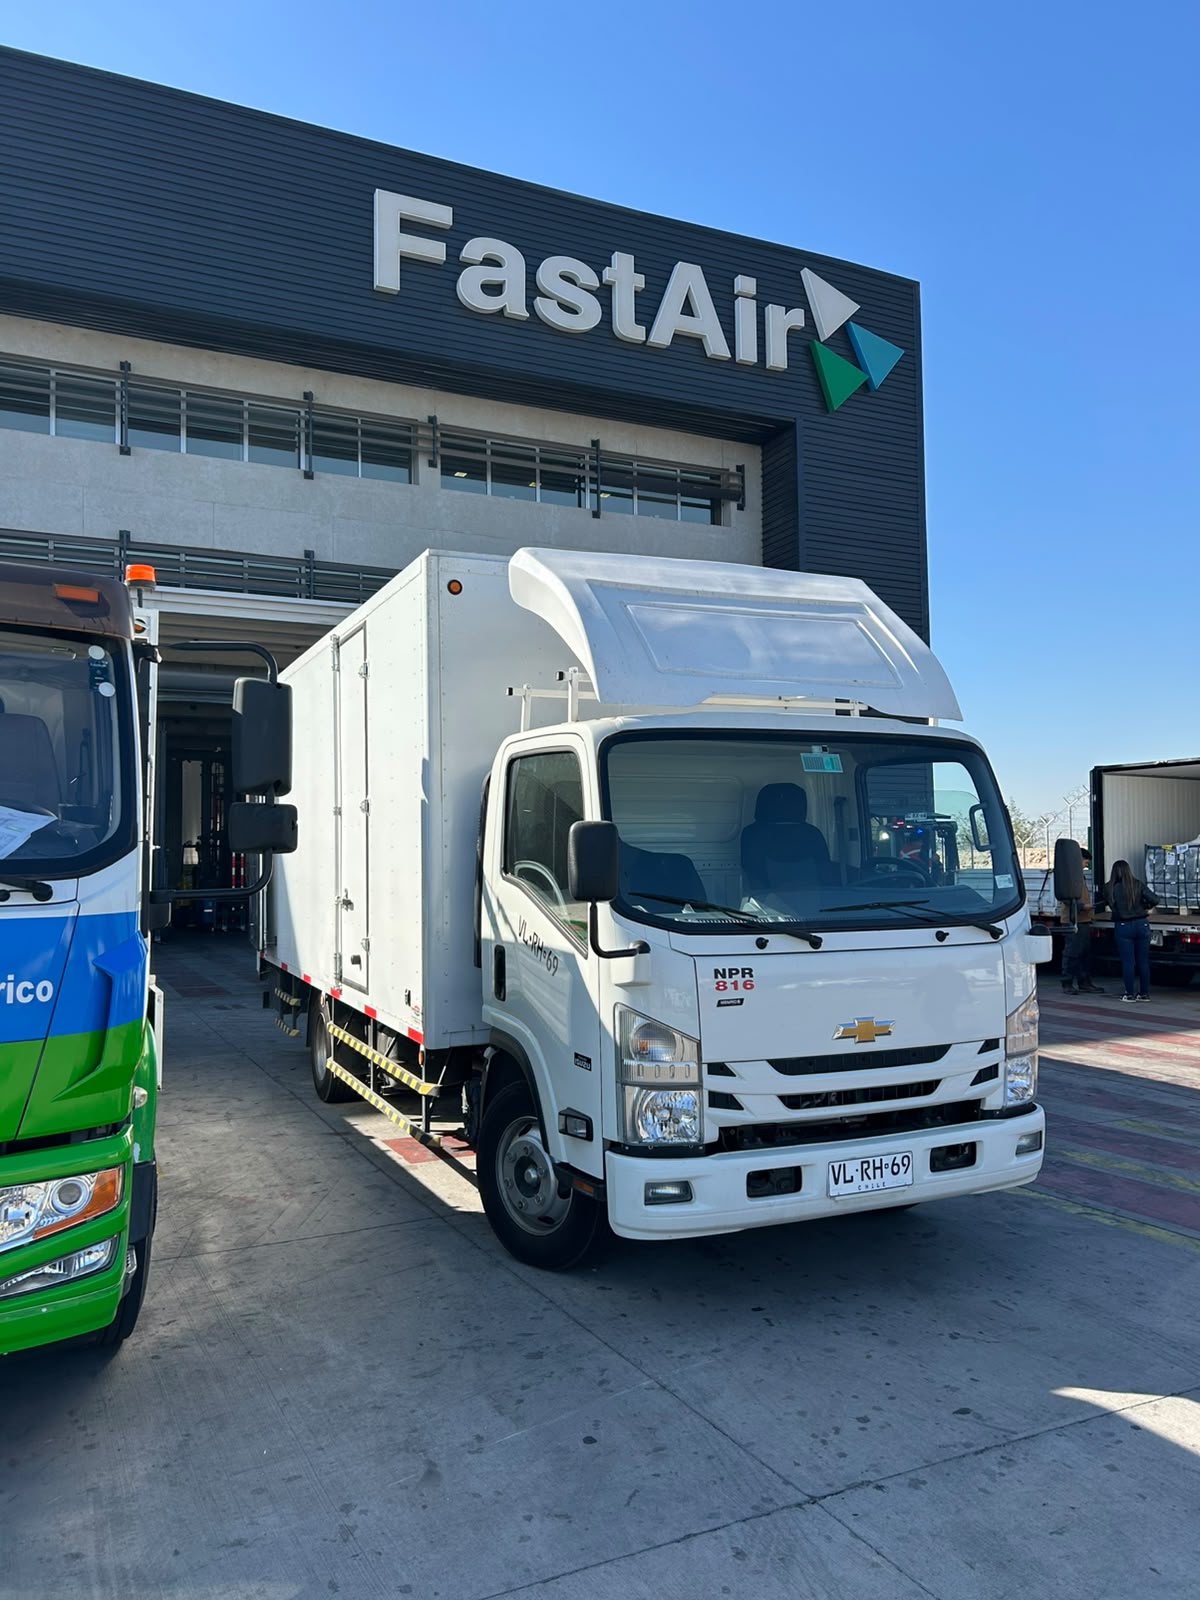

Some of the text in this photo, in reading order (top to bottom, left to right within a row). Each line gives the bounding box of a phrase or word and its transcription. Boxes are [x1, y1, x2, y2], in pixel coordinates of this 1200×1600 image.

[373, 188, 805, 371] FastAir
[714, 967, 754, 979] NPR
[715, 979, 755, 991] 816
[857, 1181, 886, 1190] CHILE
